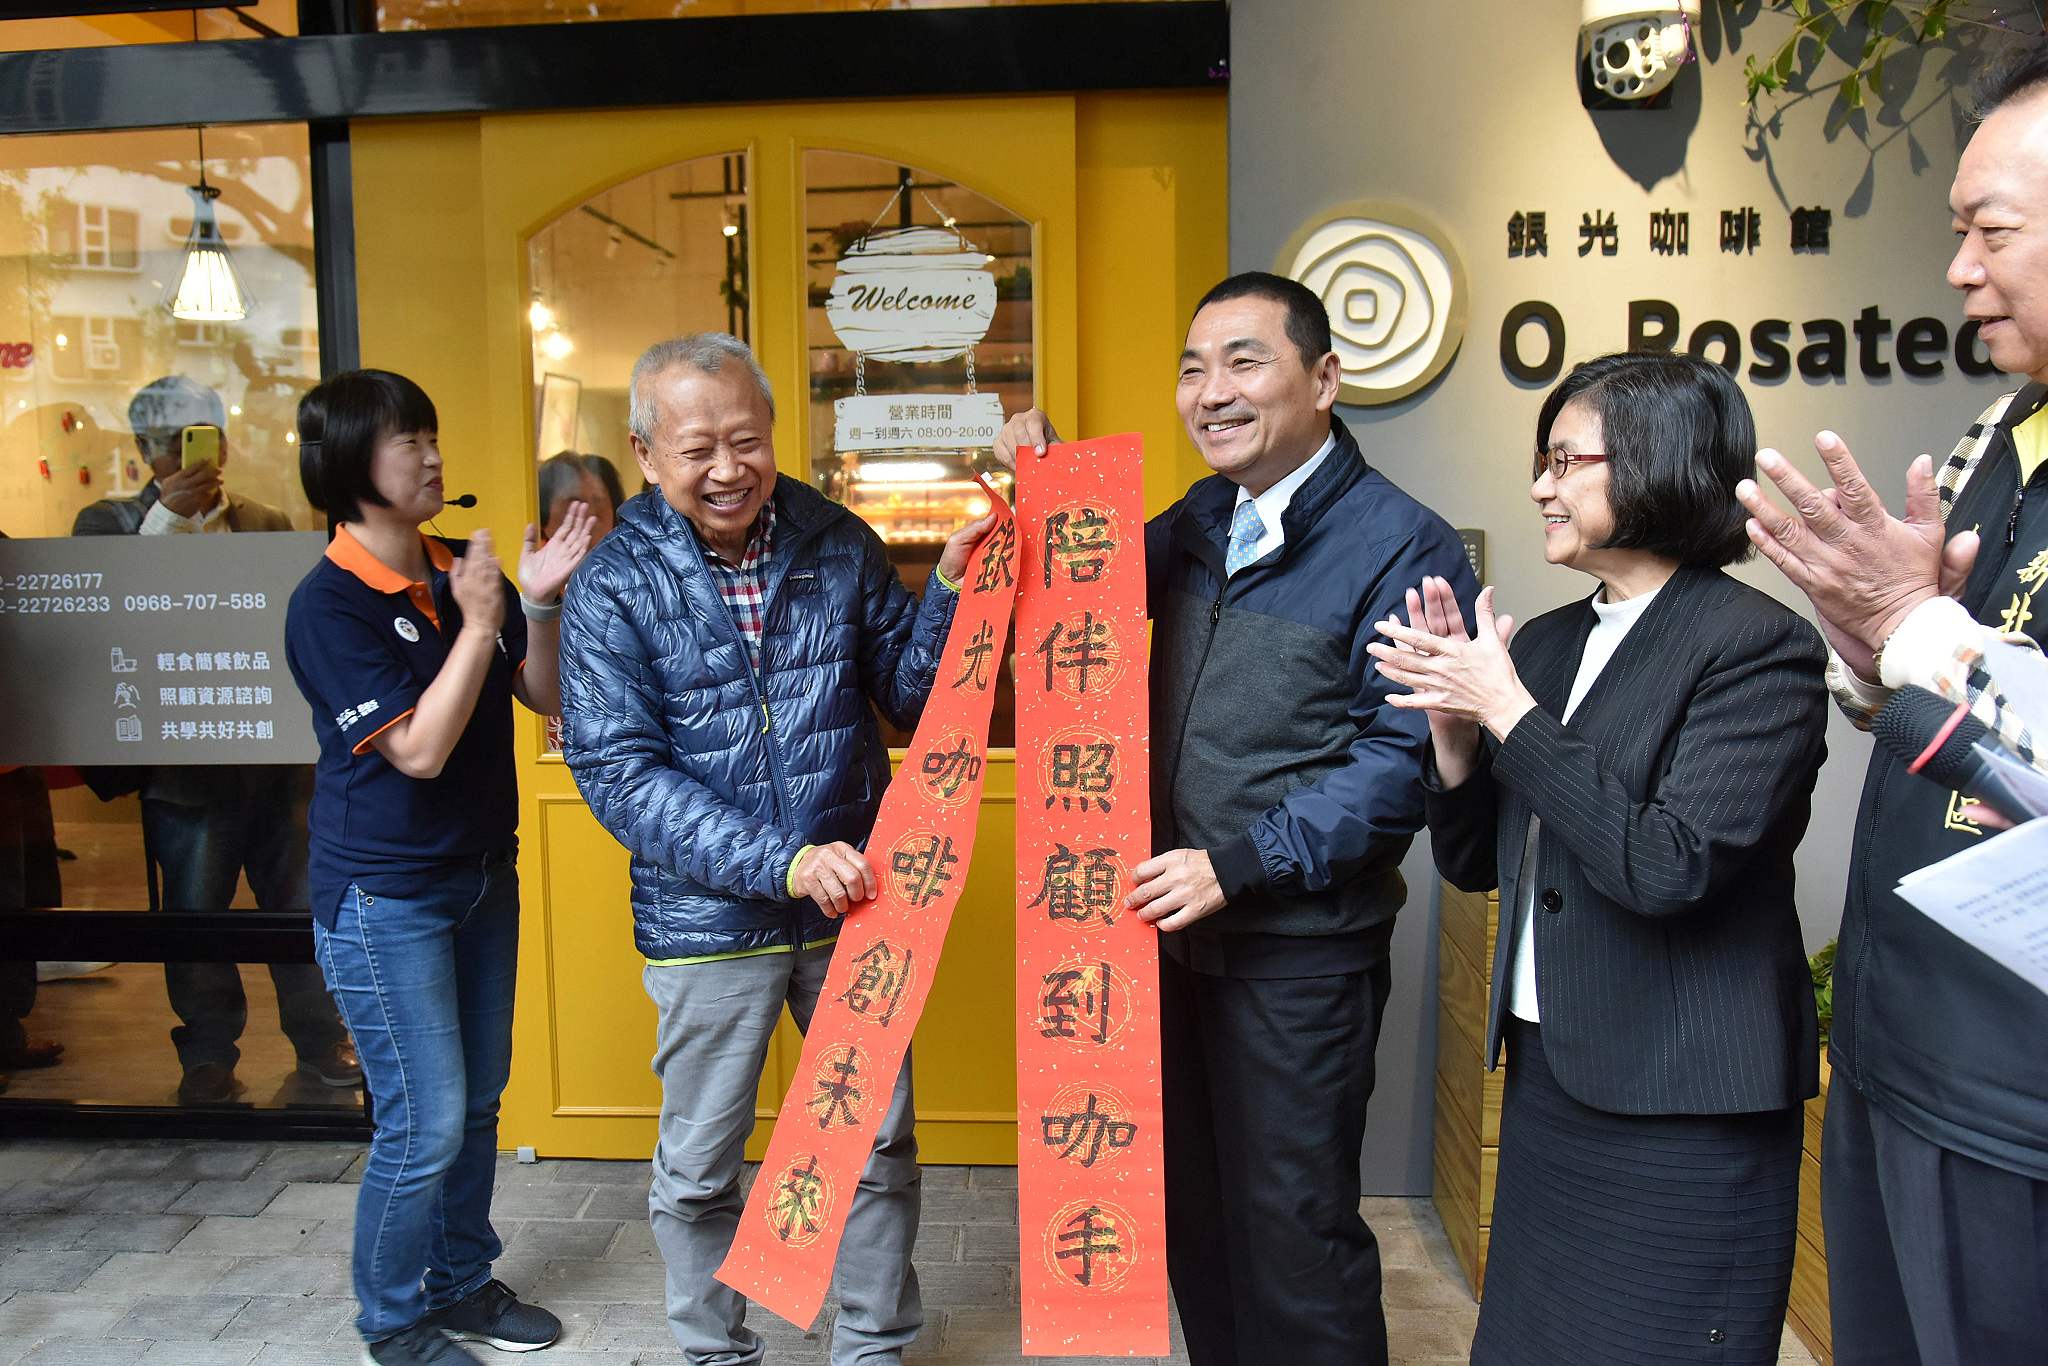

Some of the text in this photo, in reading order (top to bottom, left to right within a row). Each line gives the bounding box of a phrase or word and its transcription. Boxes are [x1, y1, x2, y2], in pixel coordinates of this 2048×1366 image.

[1507, 206, 1832, 256] 銀光咖啡館
[847, 284, 976, 312] Welcome
[1500, 300, 1585, 382] O
[889, 404, 953, 421] 營業時間
[850, 426, 993, 440] 週一到週六 08:00-20:00
[124, 593, 266, 611] 0968-707-588
[156, 652, 271, 671] 輕食簡餐飲品
[159, 687, 272, 705] 照顧資源諮詢
[161, 721, 274, 740] 共學共好共創
[1027, 508, 1138, 1287] 陪伴照顧到咖手
